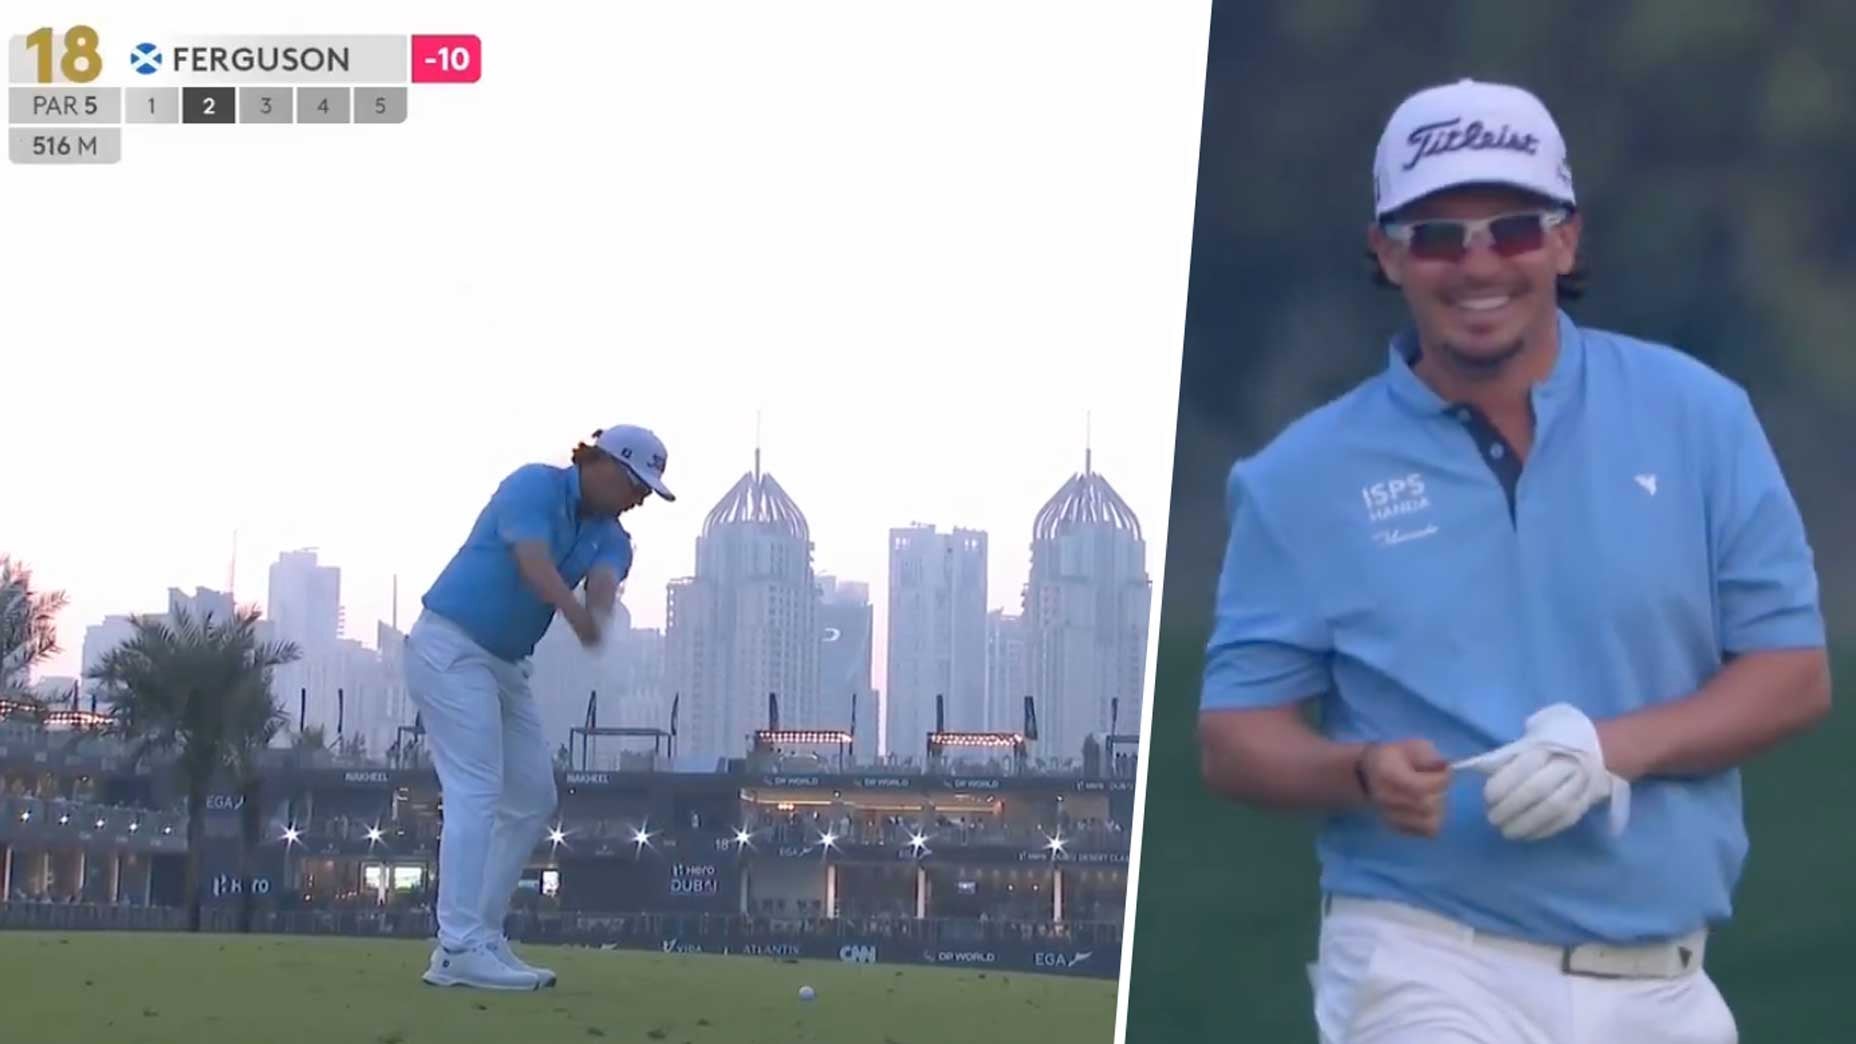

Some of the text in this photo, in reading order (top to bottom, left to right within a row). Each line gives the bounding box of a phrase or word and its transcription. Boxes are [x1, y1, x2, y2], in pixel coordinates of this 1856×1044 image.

[1403, 117, 1540, 171] Titleist
[1361, 473, 1425, 509] ISPS
[206, 795, 233, 809] EGA
[715, 837, 729, 850] 18
[231, 879, 269, 893] Hro
[671, 879, 718, 893] DUBAI
[840, 946, 876, 963] CNN
[938, 952, 995, 962] DP WORLD
[1035, 953, 1066, 967] EGA
